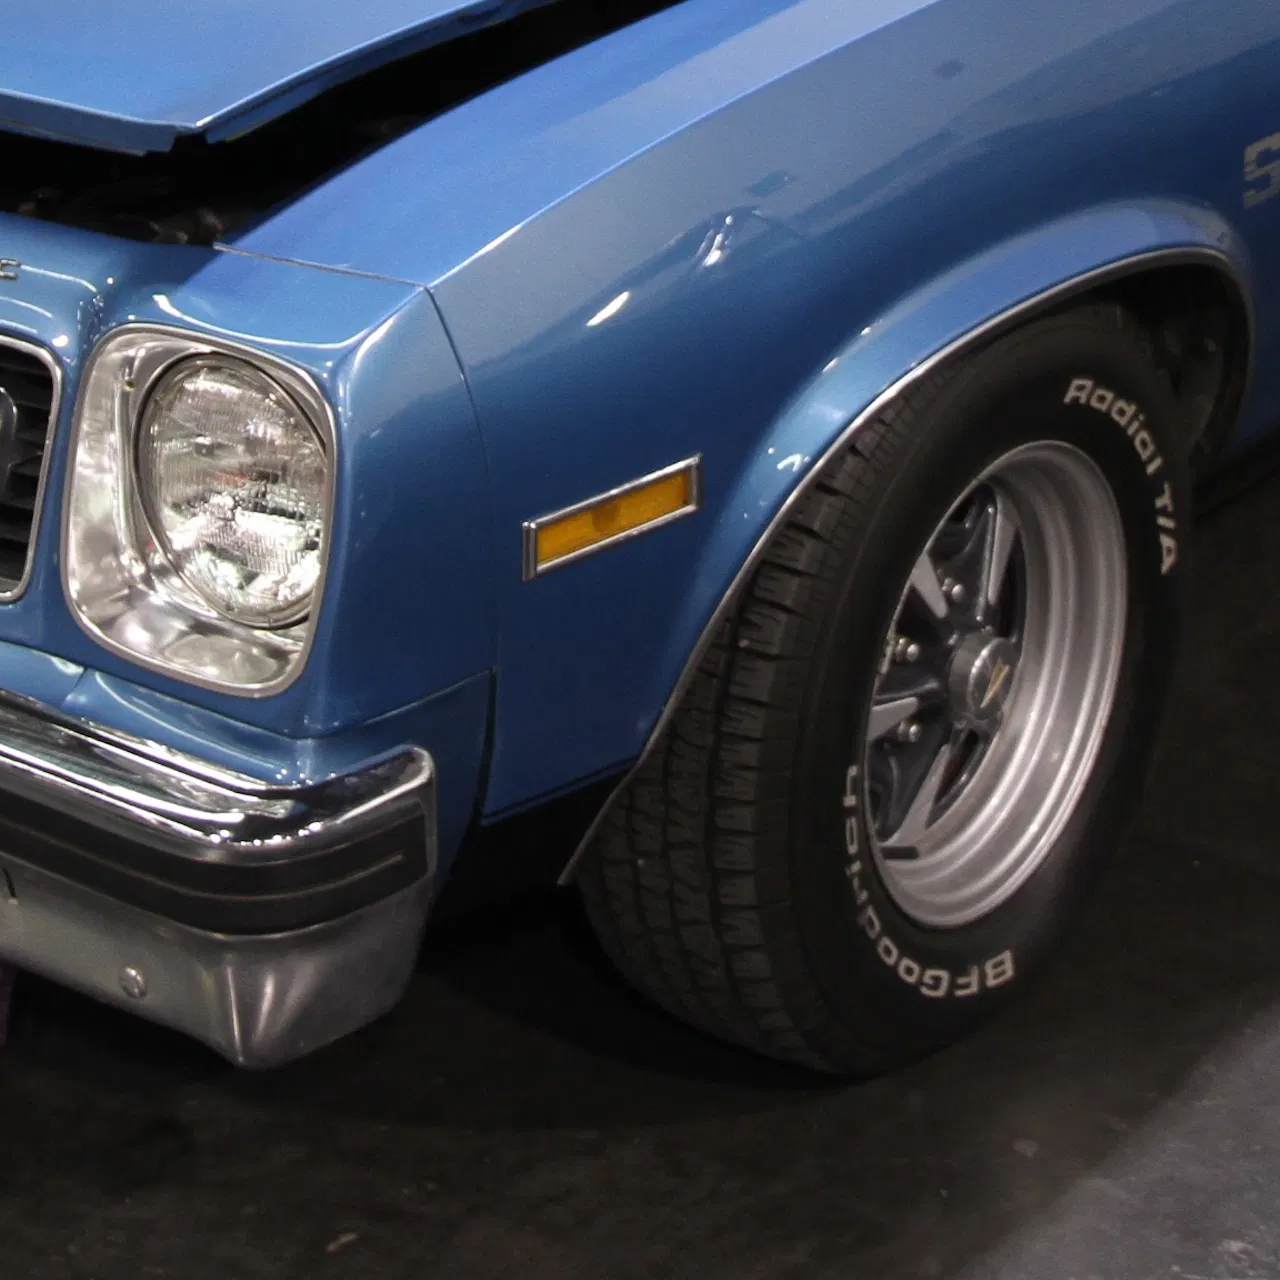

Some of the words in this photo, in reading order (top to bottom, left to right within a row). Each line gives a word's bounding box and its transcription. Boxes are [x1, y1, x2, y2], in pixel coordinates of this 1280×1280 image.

[1063, 377, 1164, 475] Radial
[1154, 480, 1178, 575] T/A
[842, 765, 1014, 998] BFGoodrich
